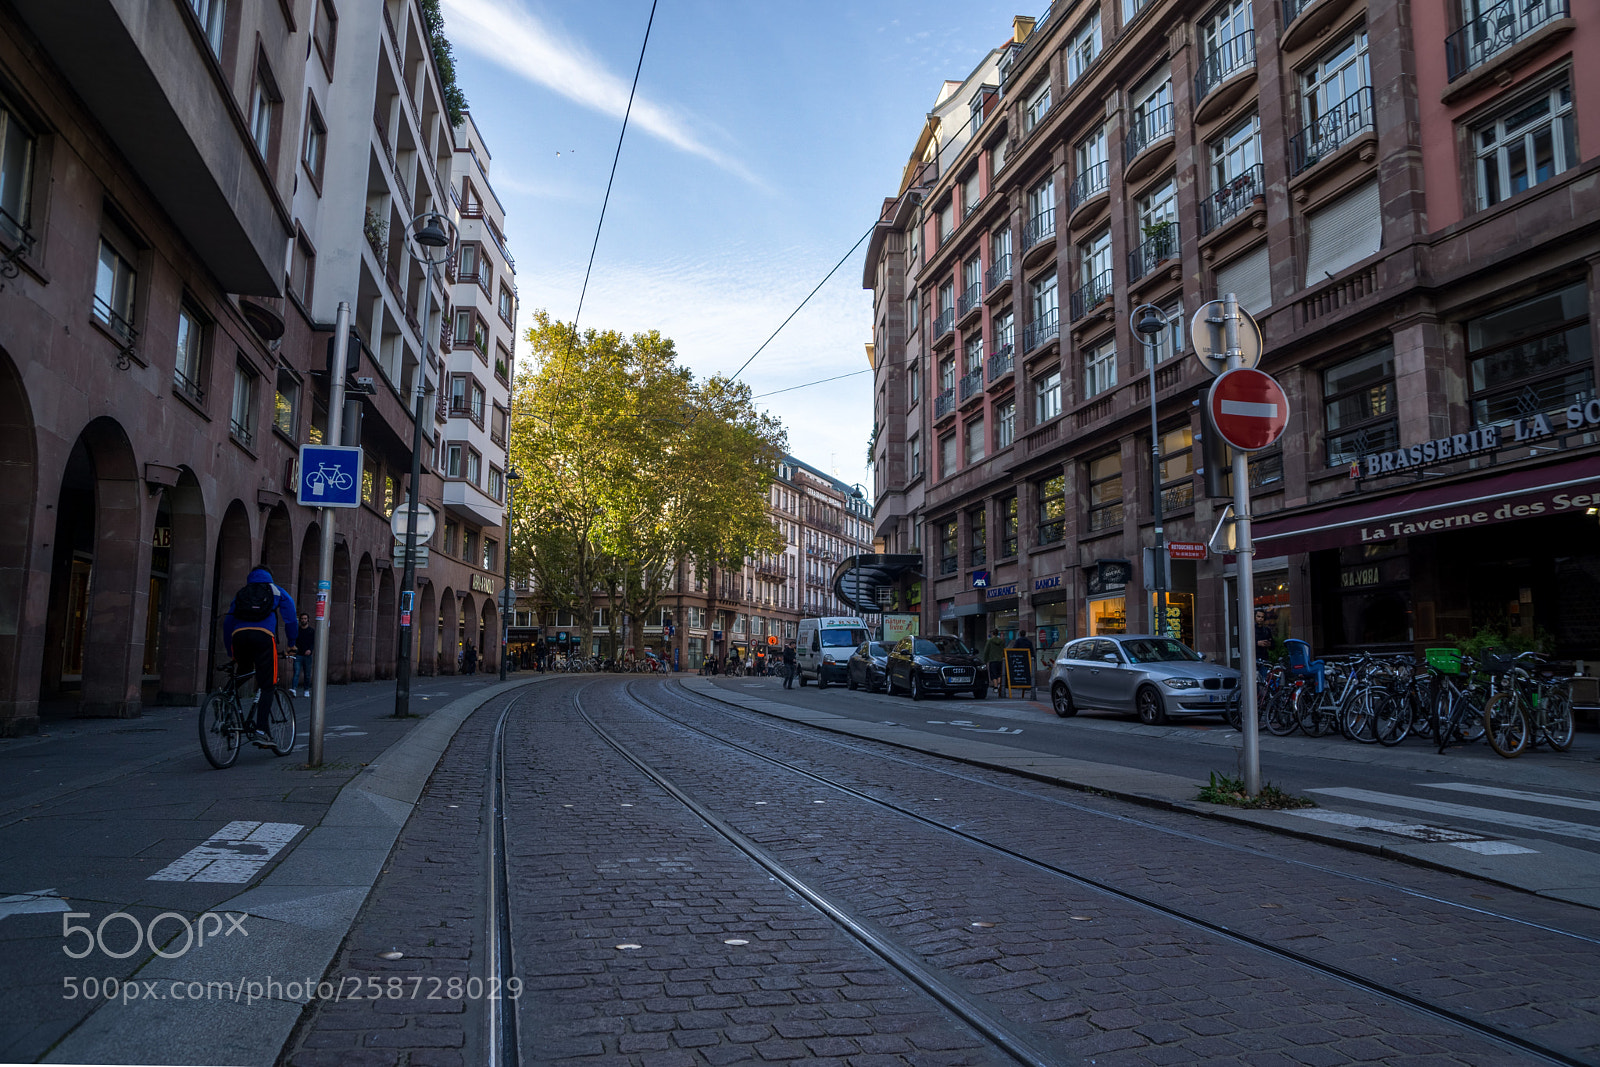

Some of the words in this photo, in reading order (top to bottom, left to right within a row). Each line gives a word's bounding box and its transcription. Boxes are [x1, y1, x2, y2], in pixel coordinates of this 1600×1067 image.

[1367, 428, 1499, 476] BRASSERIE
[1514, 413, 1552, 442] LA
[1361, 528, 1386, 542] La
[1389, 510, 1488, 536] Taverne
[1493, 501, 1546, 519] des
[987, 585, 1017, 599] ASSURANCE
[1035, 576, 1061, 590] BANQUE
